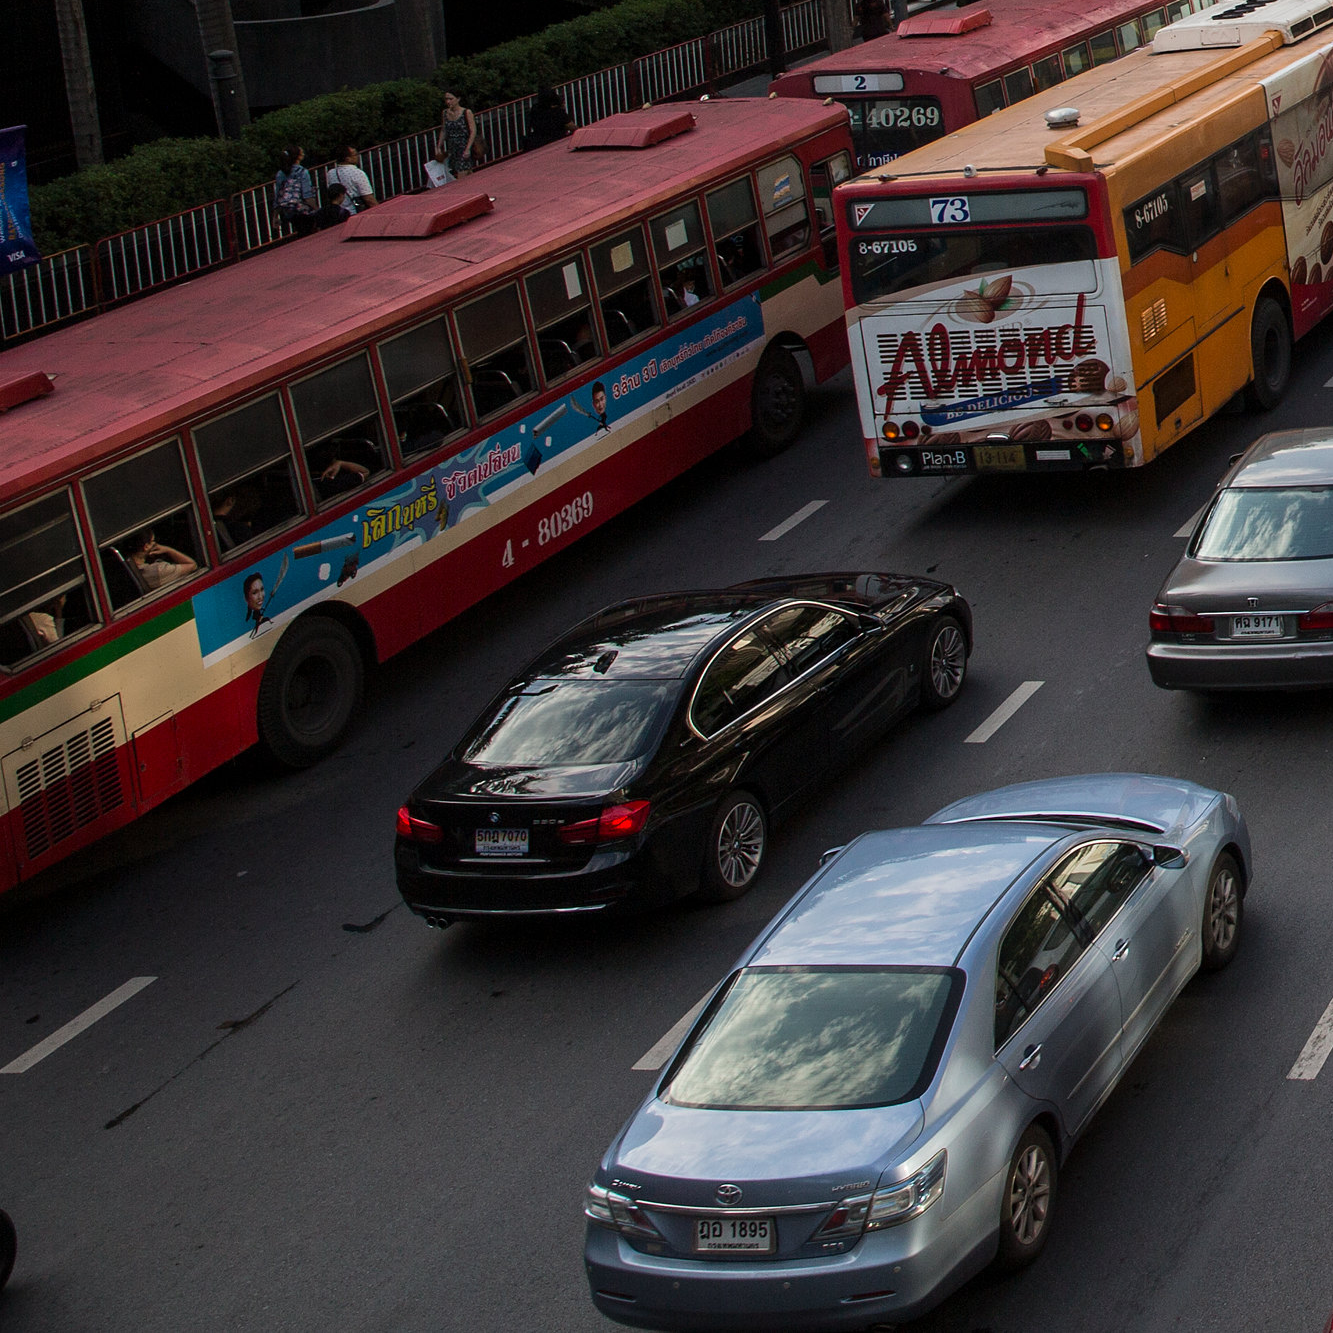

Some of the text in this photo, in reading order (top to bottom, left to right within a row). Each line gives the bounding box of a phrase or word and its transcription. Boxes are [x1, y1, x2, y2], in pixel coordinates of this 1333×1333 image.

[854, 76, 867, 90] 2
[930, 198, 970, 223] 73
[1135, 193, 1168, 229] 8-67105
[859, 239, 917, 255] 8-67105
[7, 250, 26, 263] VISA
[878, 293, 1097, 419] Almond
[361, 475, 438, 549] เลิกบุหรี่
[502, 539, 515, 569] 4
[538, 491, 594, 547] 80369
[1254, 617, 1279, 628] 9171
[501, 830, 527, 842] 7070
[730, 1221, 768, 1238] 1895
